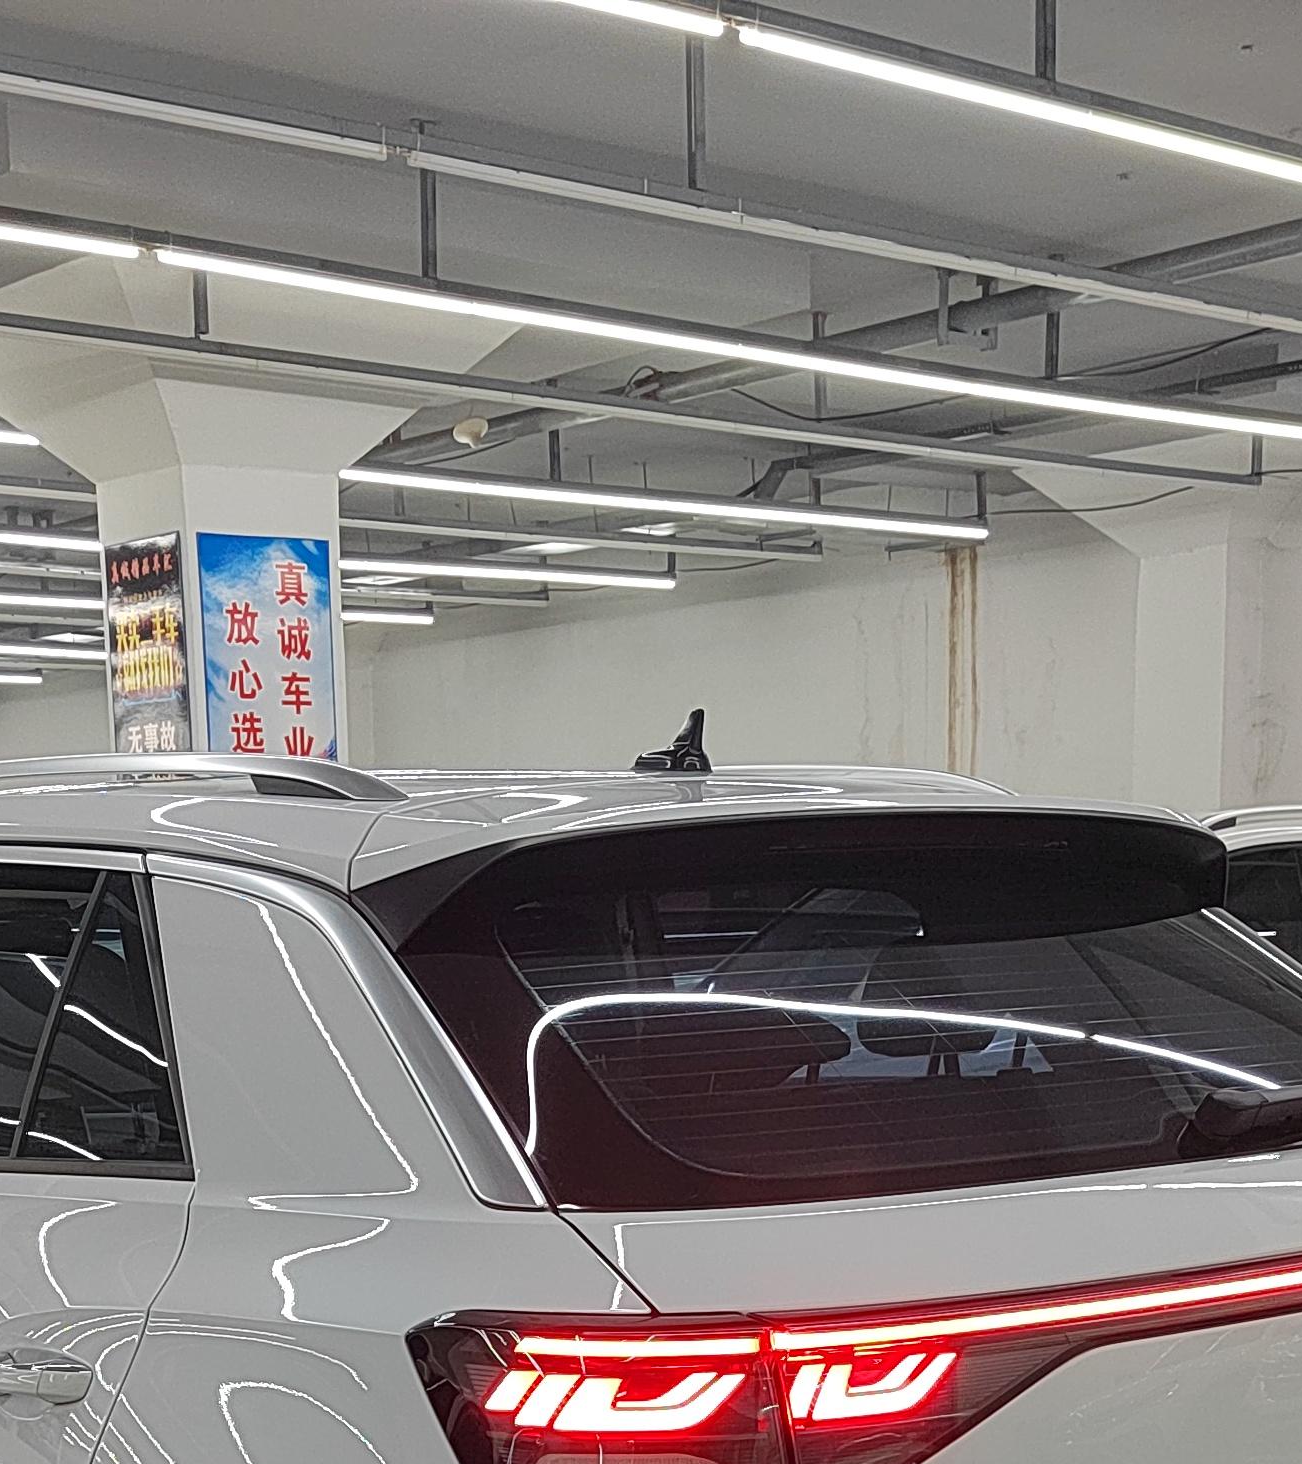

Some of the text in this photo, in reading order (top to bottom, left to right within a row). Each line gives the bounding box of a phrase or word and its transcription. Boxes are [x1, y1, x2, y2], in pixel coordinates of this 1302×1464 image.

[224, 602, 266, 753] 放心选
[275, 562, 314, 757] 真诚车业
[128, 720, 176, 753] 无事故
